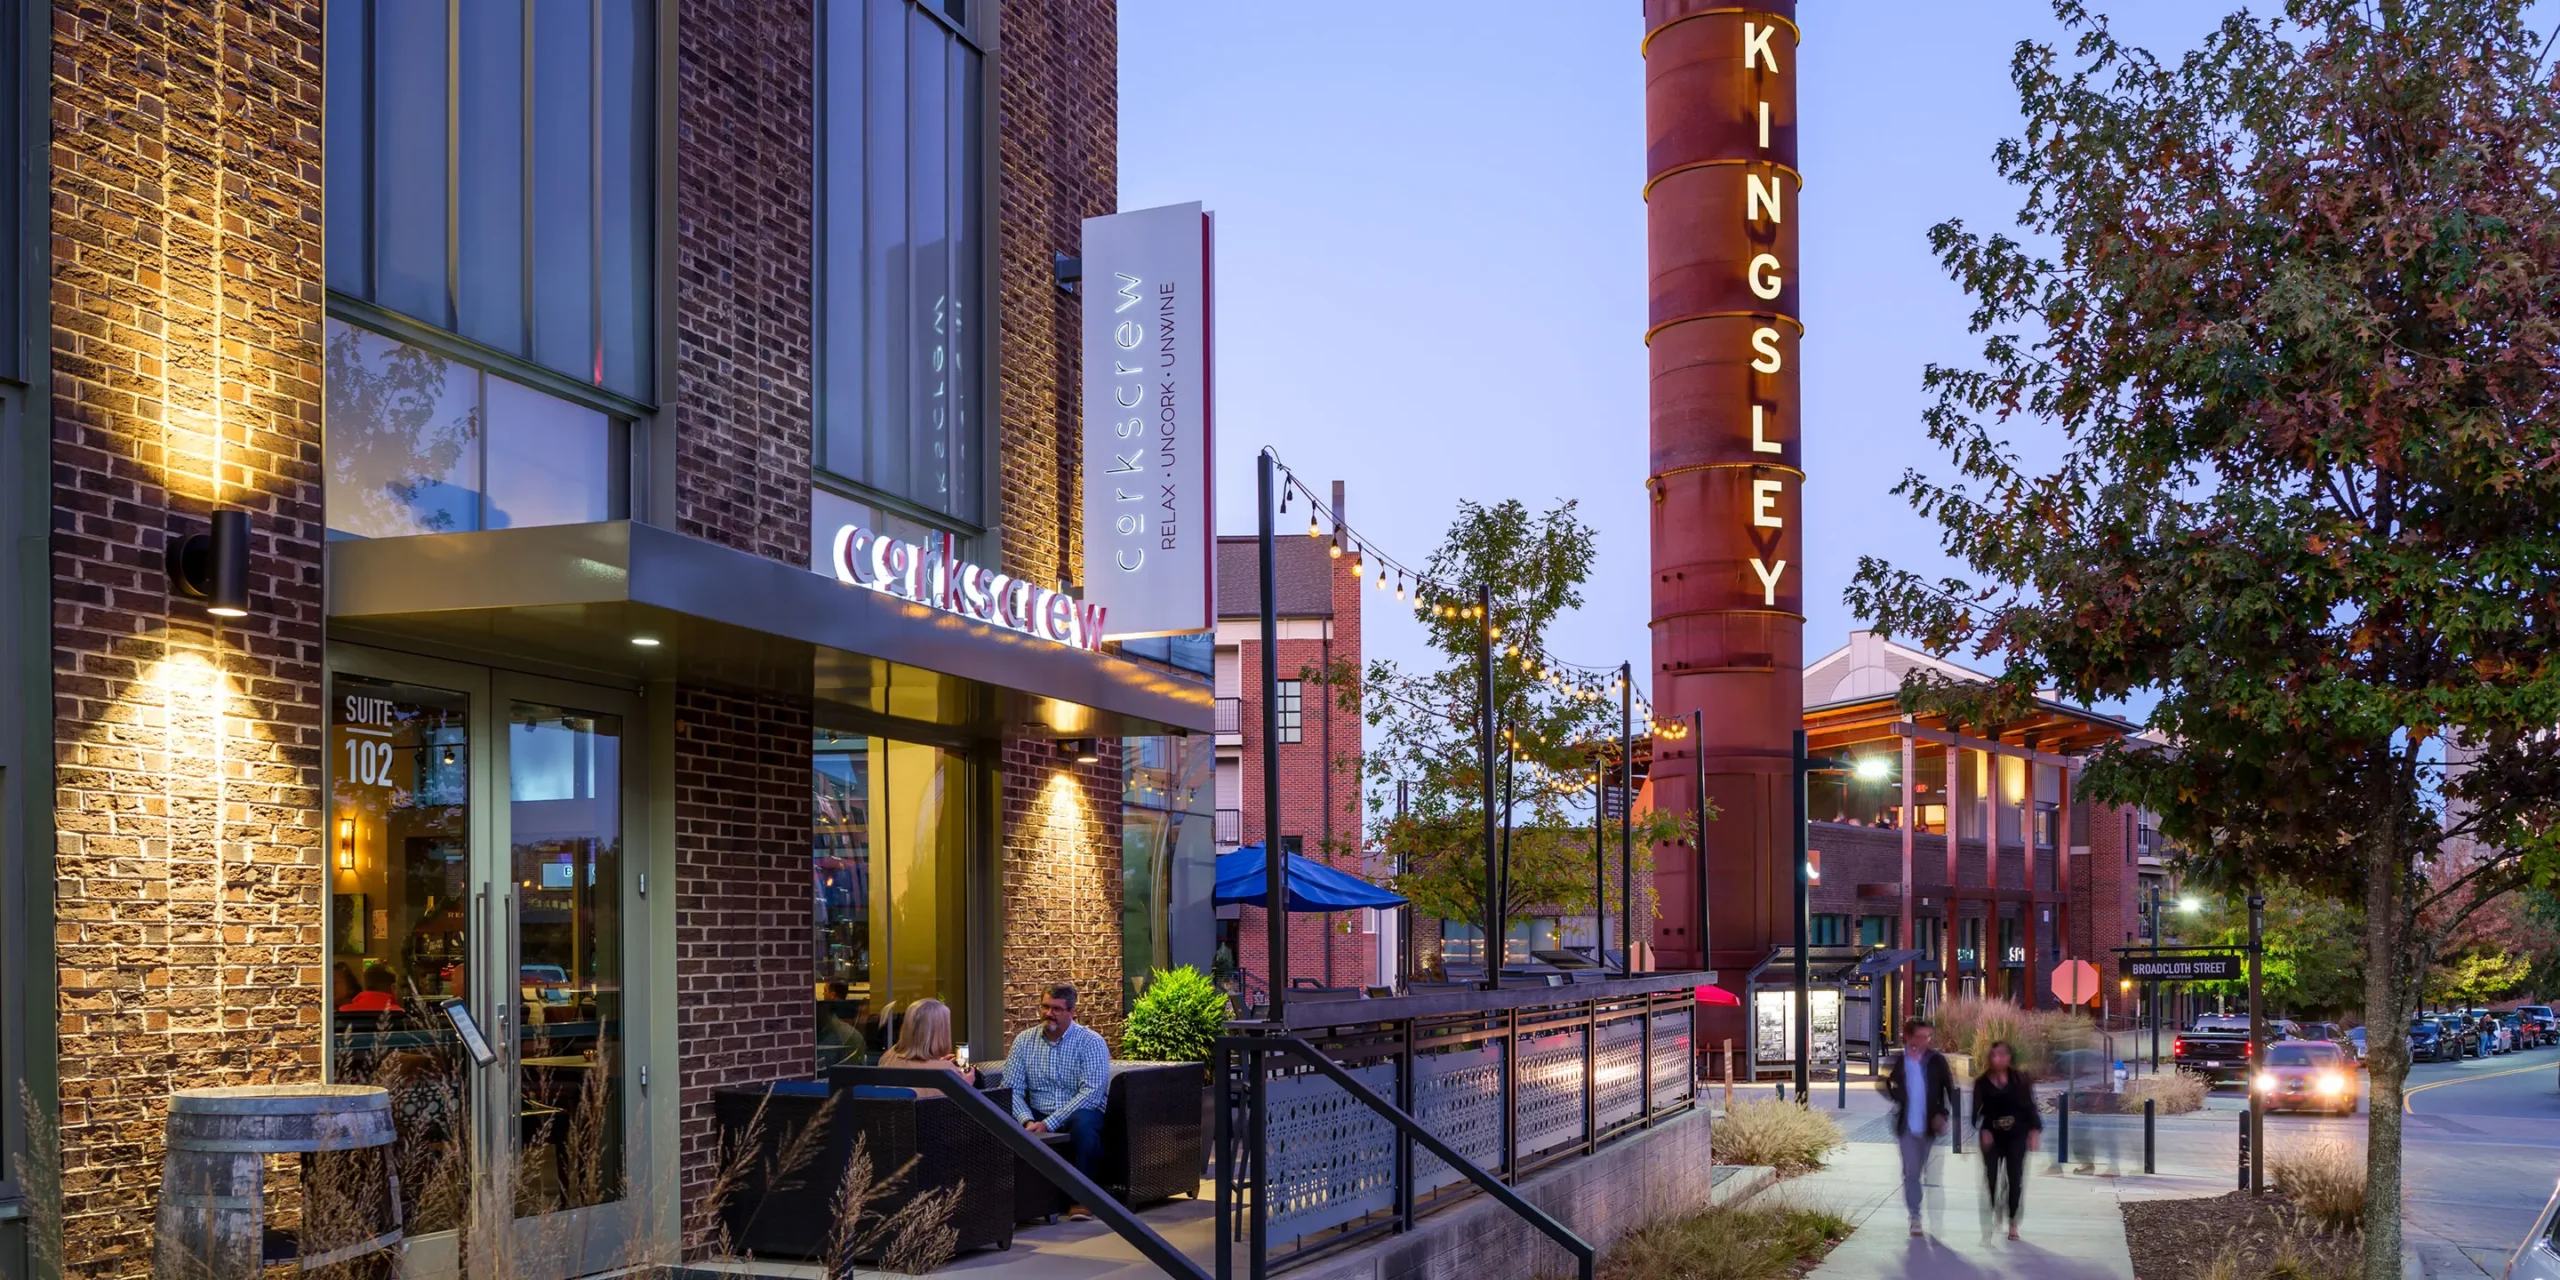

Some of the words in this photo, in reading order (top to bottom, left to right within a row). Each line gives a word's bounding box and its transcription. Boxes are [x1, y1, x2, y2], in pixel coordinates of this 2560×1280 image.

[1160, 282, 1175, 367] UNWINE
[1743, 22, 1786, 606] KINGSLEY
[1105, 271, 1144, 571] corkscrew
[1160, 381, 1176, 468] UNCORK
[1161, 484, 1176, 550] RELAX
[841, 527, 1107, 652] corkscrew
[345, 695, 393, 727] SUITE
[345, 738, 393, 787] 102
[2132, 962, 2192, 975] BROADCLOTH
[2193, 961, 2226, 974] STREET
